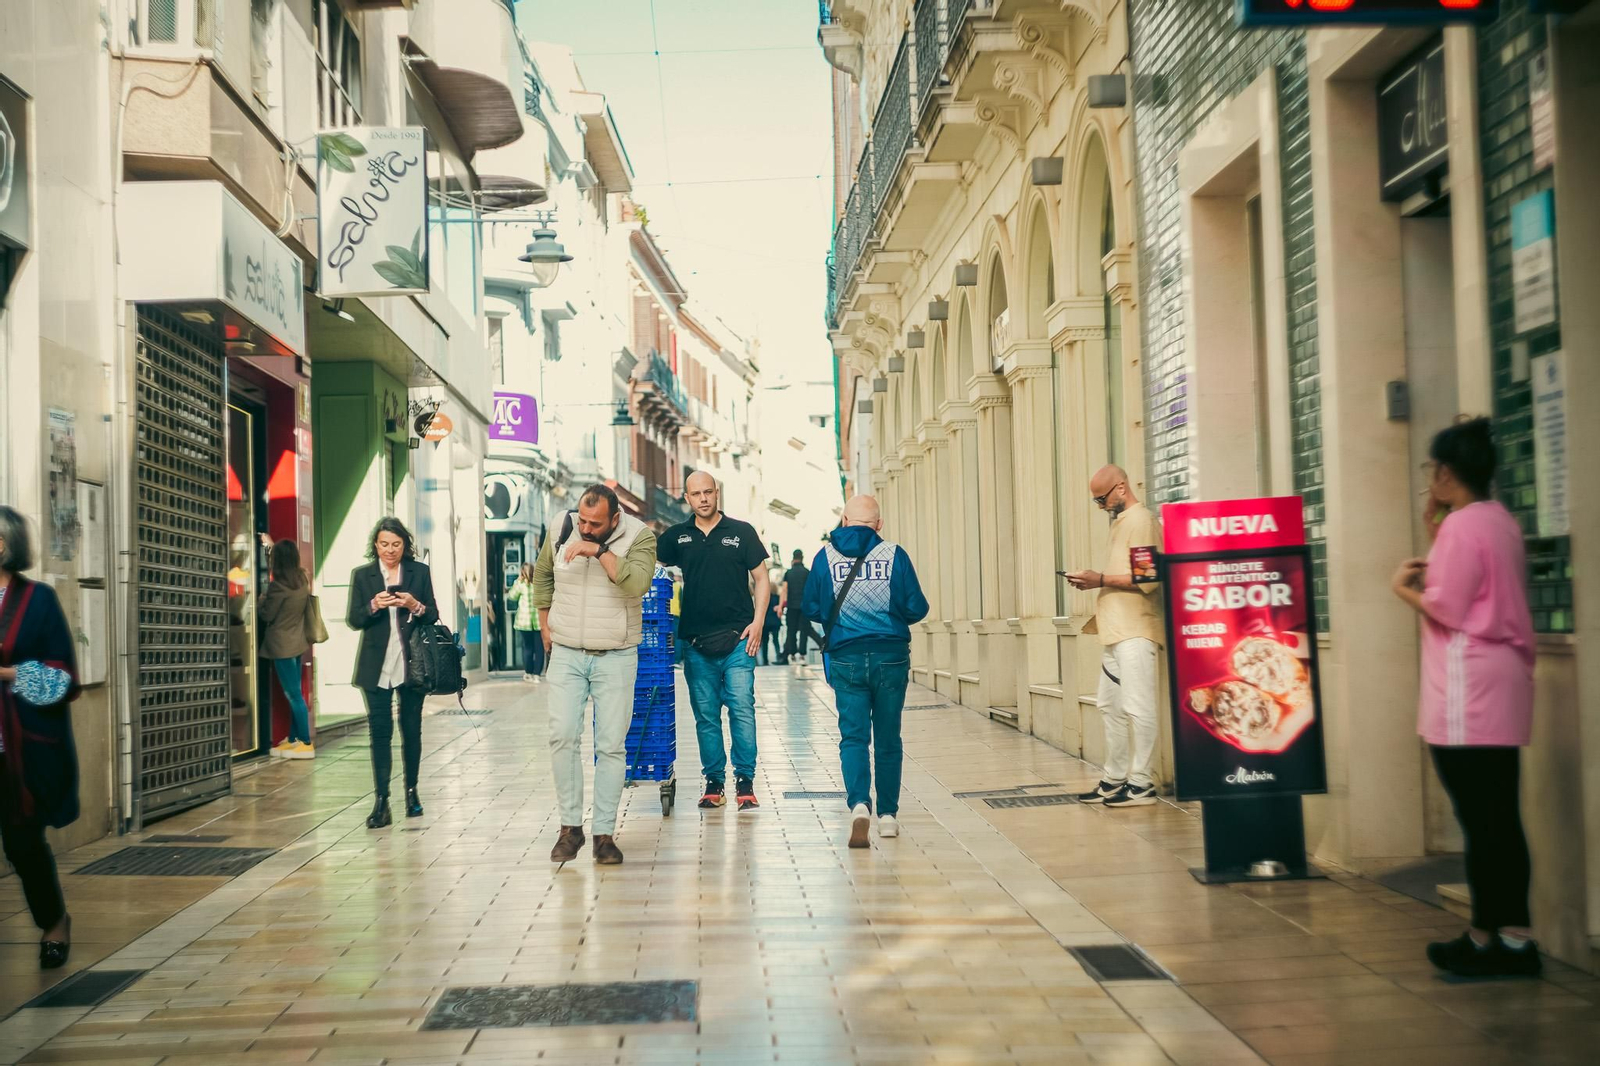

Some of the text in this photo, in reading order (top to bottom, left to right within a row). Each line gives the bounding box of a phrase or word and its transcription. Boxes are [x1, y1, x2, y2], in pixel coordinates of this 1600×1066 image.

[371, 131, 421, 141] Desde 1992
[1189, 514, 1278, 537] NUEVA
[1208, 561, 1264, 574] RÍNDETE
[1189, 571, 1280, 586] AL AUTÉNTICO
[1184, 583, 1293, 612] SABOR
[1182, 623, 1227, 636] KEBAB
[1226, 766, 1275, 784] Malvón
